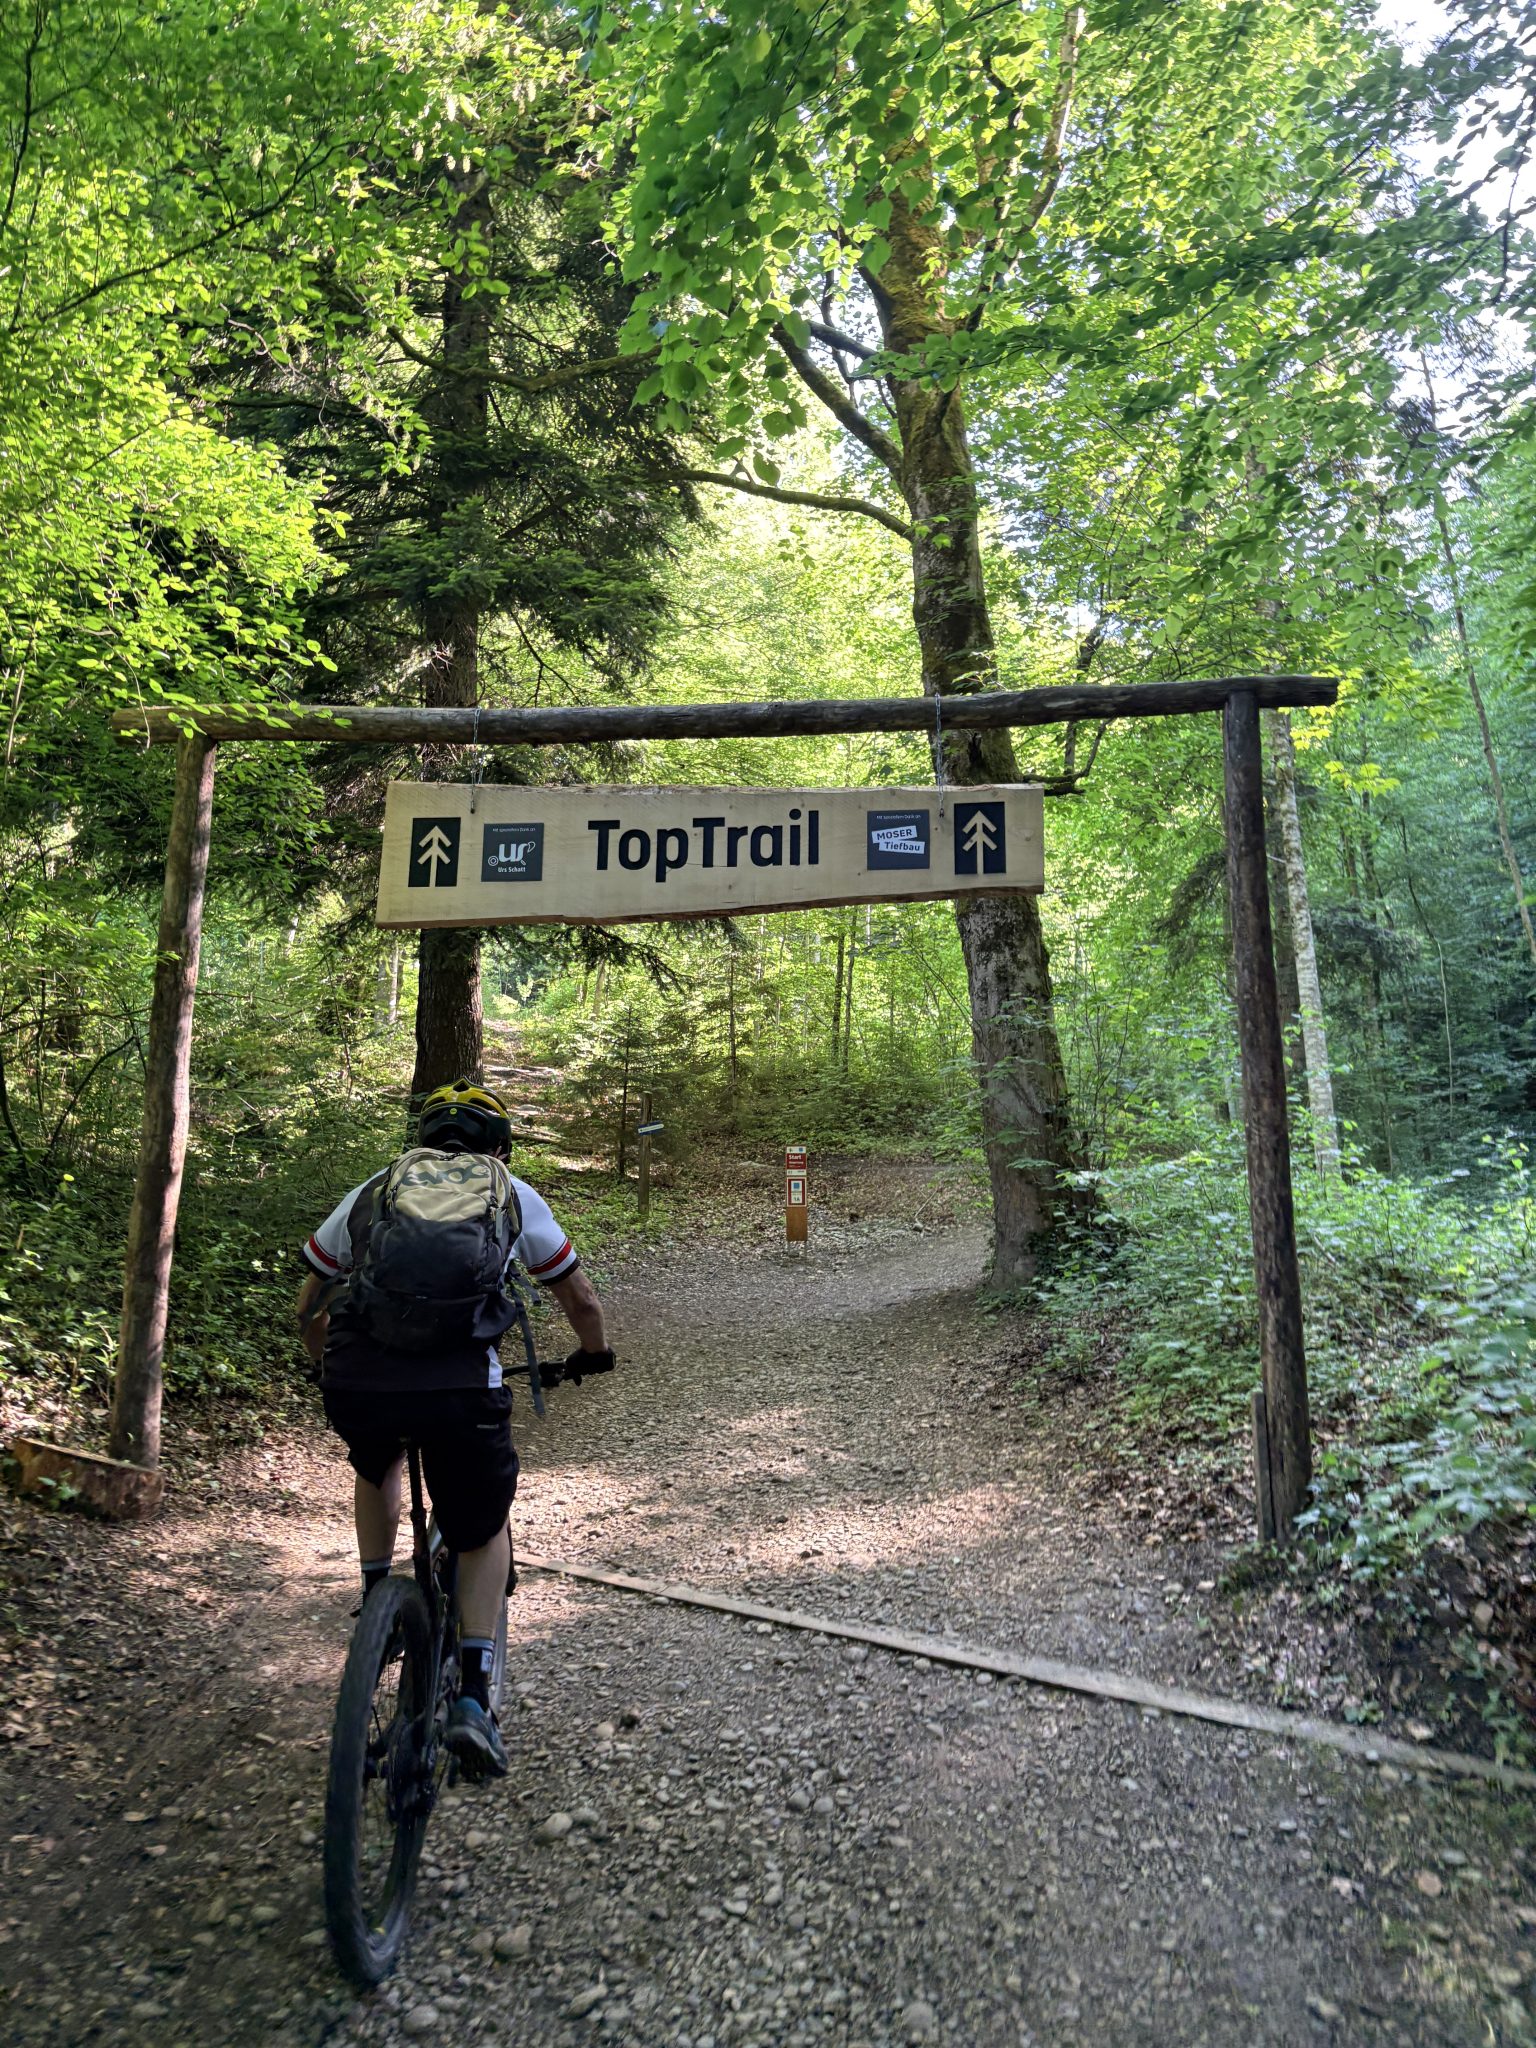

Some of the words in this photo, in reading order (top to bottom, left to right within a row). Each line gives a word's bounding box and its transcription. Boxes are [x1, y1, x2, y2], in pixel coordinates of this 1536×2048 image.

[876, 829, 912, 840] MOSER
[588, 808, 819, 883] TopTrail
[884, 841, 920, 851] Tiefbau
